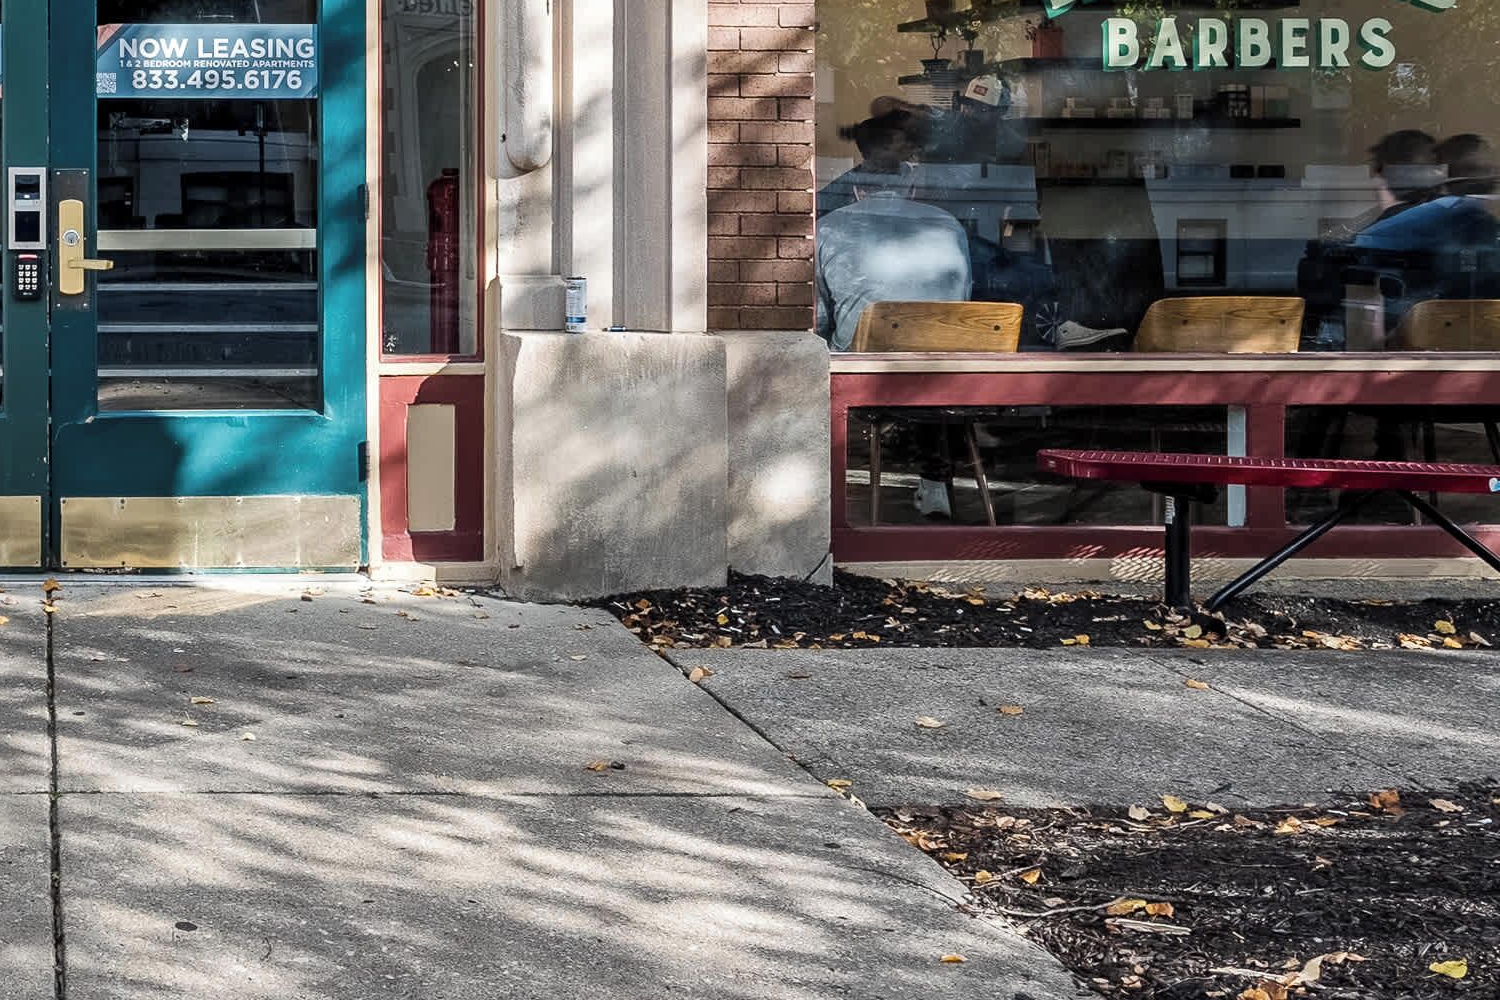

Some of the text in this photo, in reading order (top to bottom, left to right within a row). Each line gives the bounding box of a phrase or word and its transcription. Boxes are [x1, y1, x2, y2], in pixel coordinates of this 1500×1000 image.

[119, 38, 315, 59] NOW LEASING
[1102, 18, 1397, 72] BARBERS
[119, 60, 315, 68] 1 & 2 BEDROOM RENOVATED APARTMENTS
[132, 69, 302, 90] 833.495.6176
